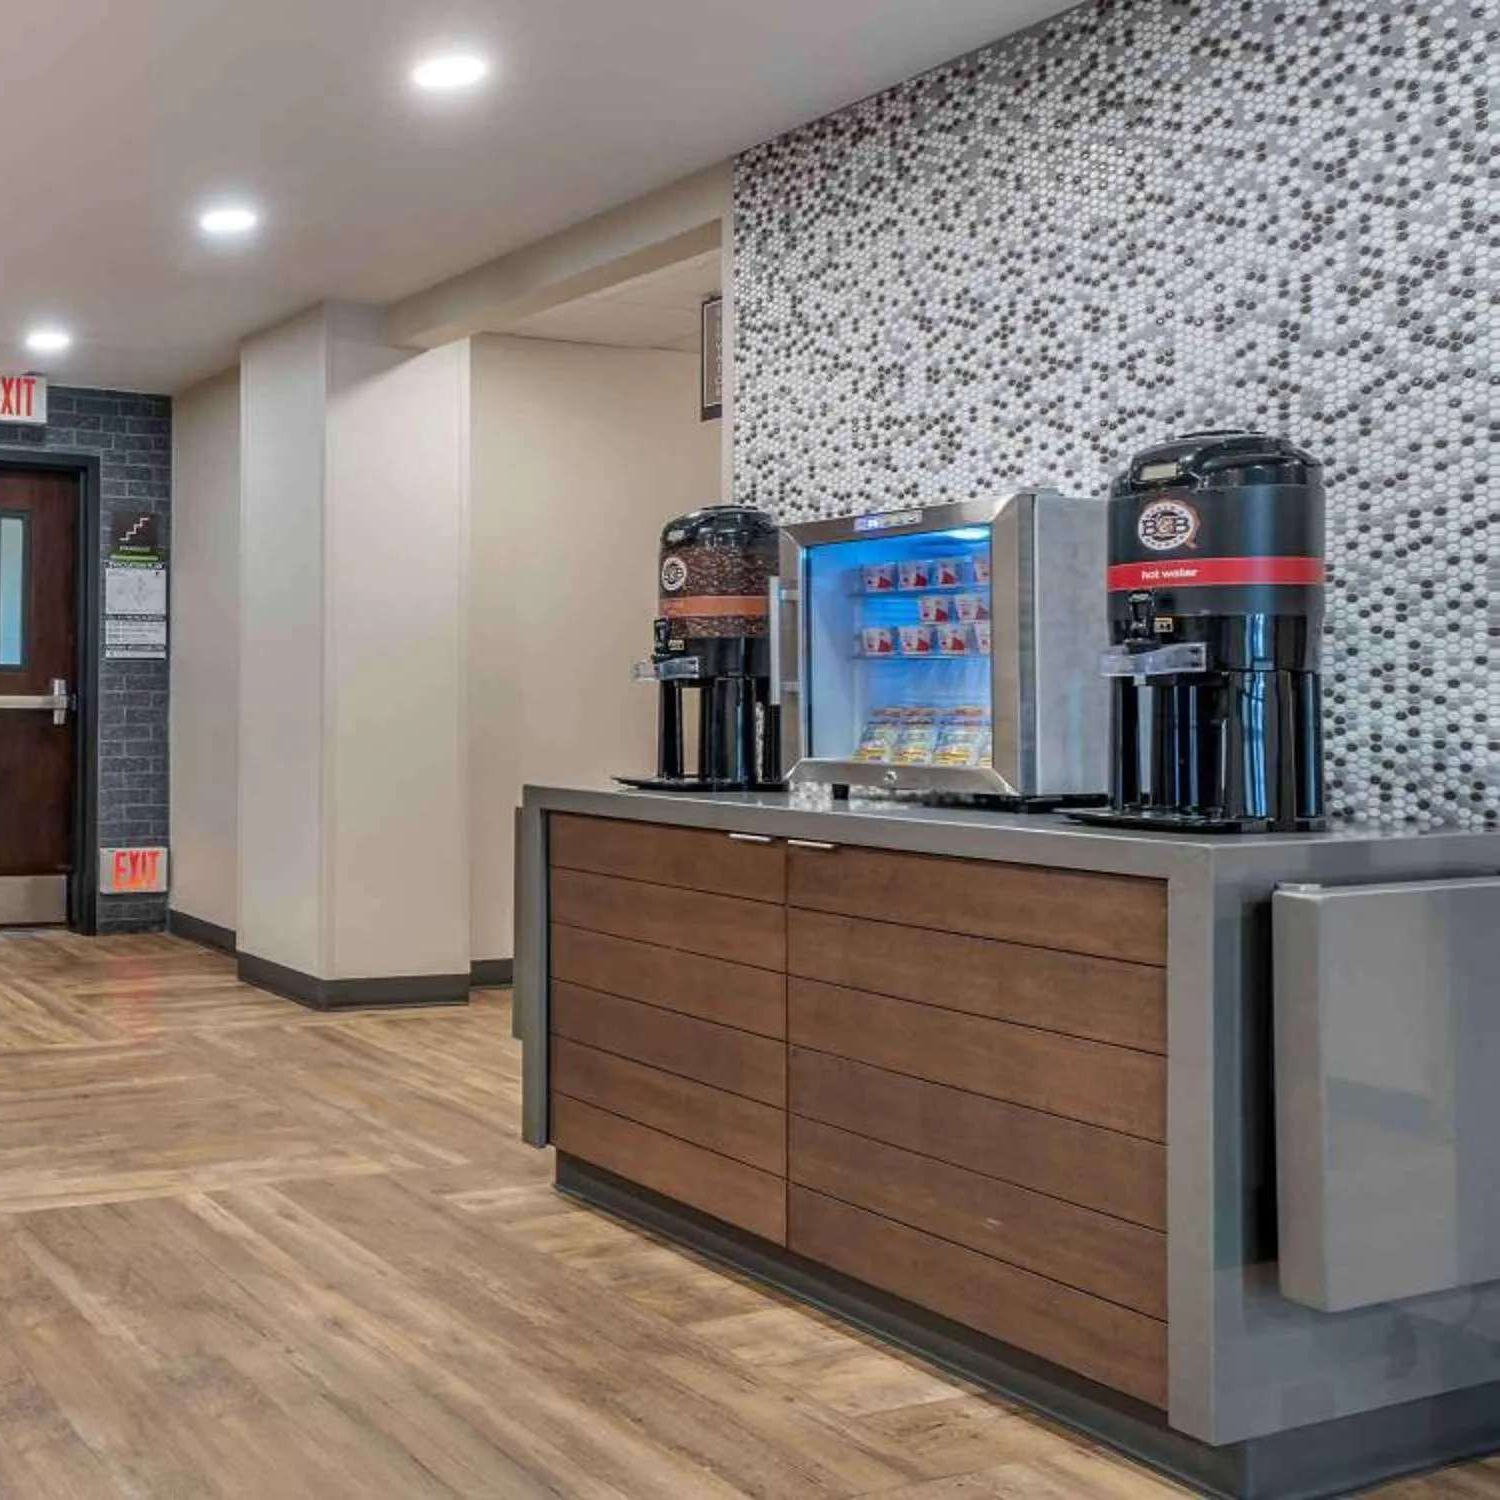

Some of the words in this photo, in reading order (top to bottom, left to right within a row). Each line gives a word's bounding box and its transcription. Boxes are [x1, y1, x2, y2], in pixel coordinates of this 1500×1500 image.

[1141, 569, 1159, 581] hot
[1161, 567, 1199, 579] water
[113, 850, 162, 889] EXIT
